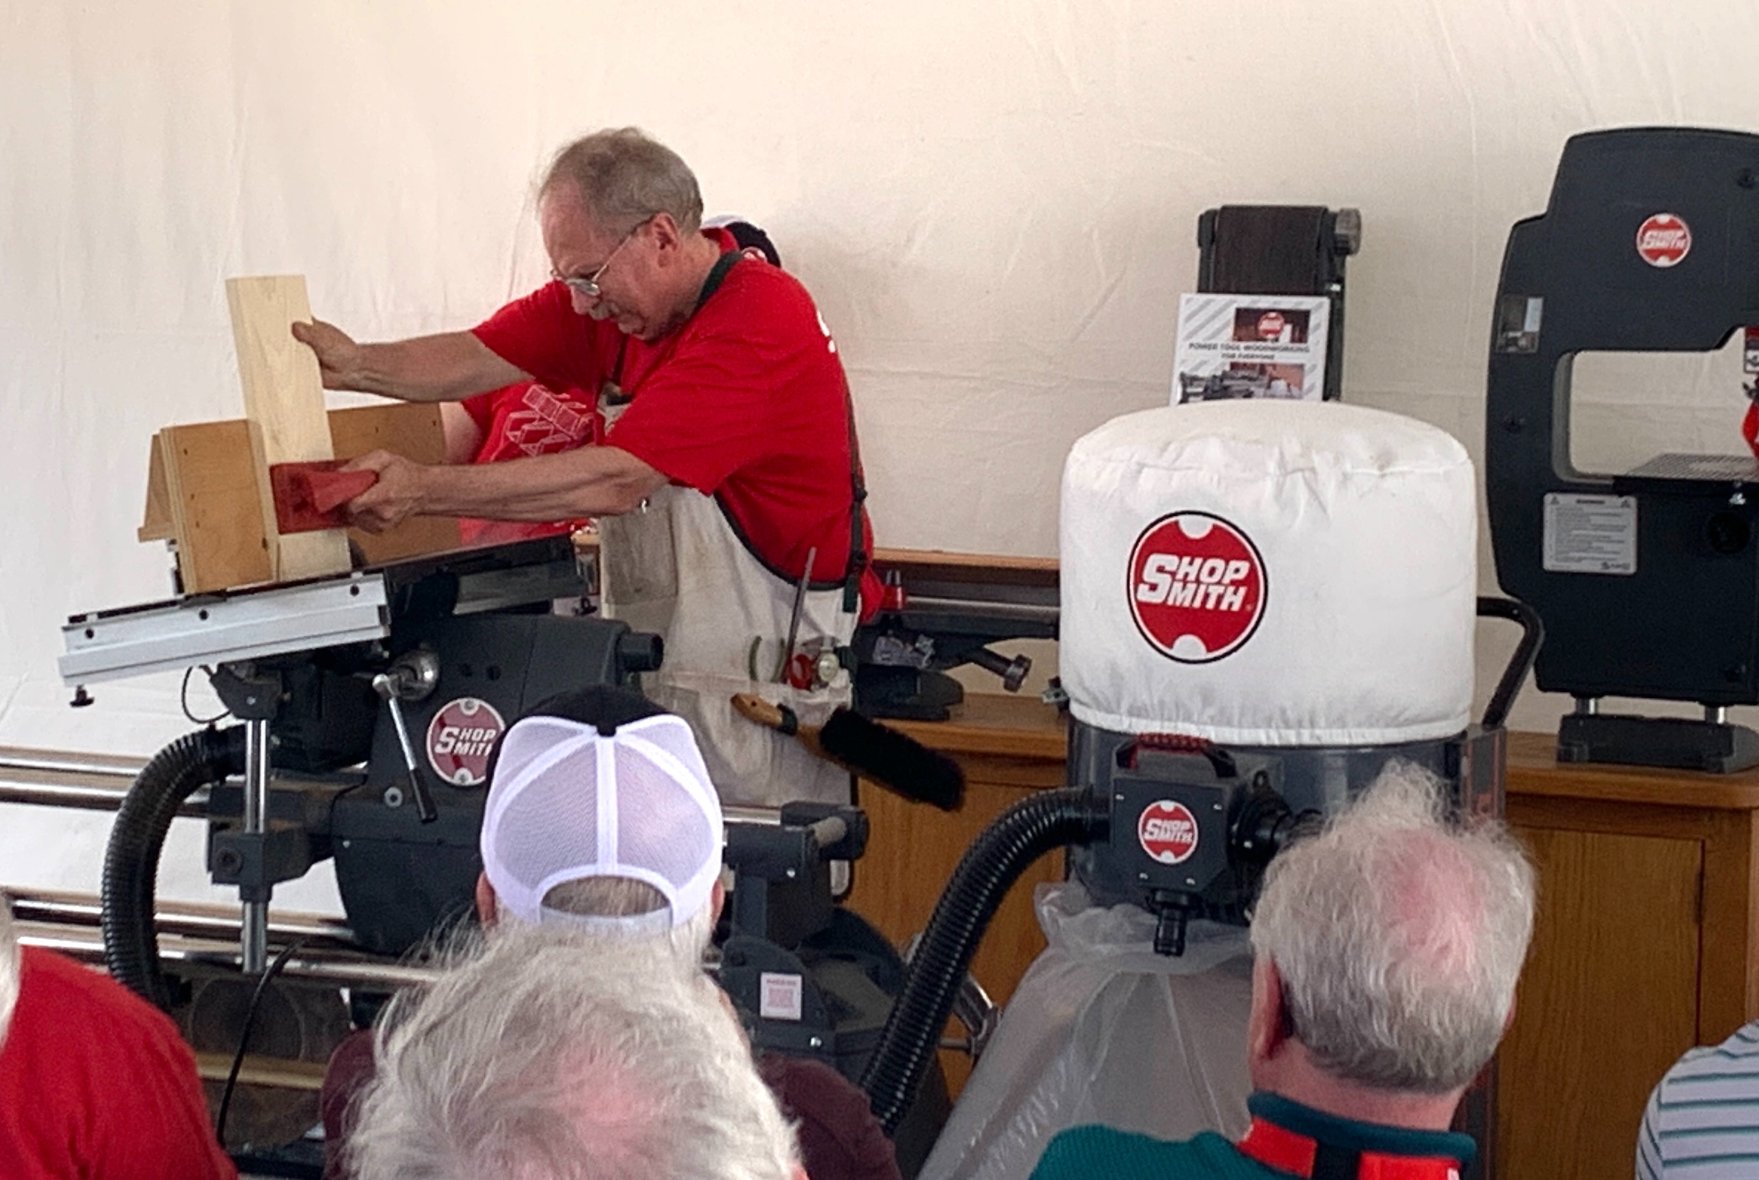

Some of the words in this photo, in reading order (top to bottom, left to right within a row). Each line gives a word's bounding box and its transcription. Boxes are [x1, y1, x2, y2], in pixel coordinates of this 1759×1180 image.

[1188, 342, 1218, 351] POWER
[1220, 343, 1241, 351] TOOL
[1137, 553, 1250, 594] SHOP
[434, 726, 497, 747] SHOP
